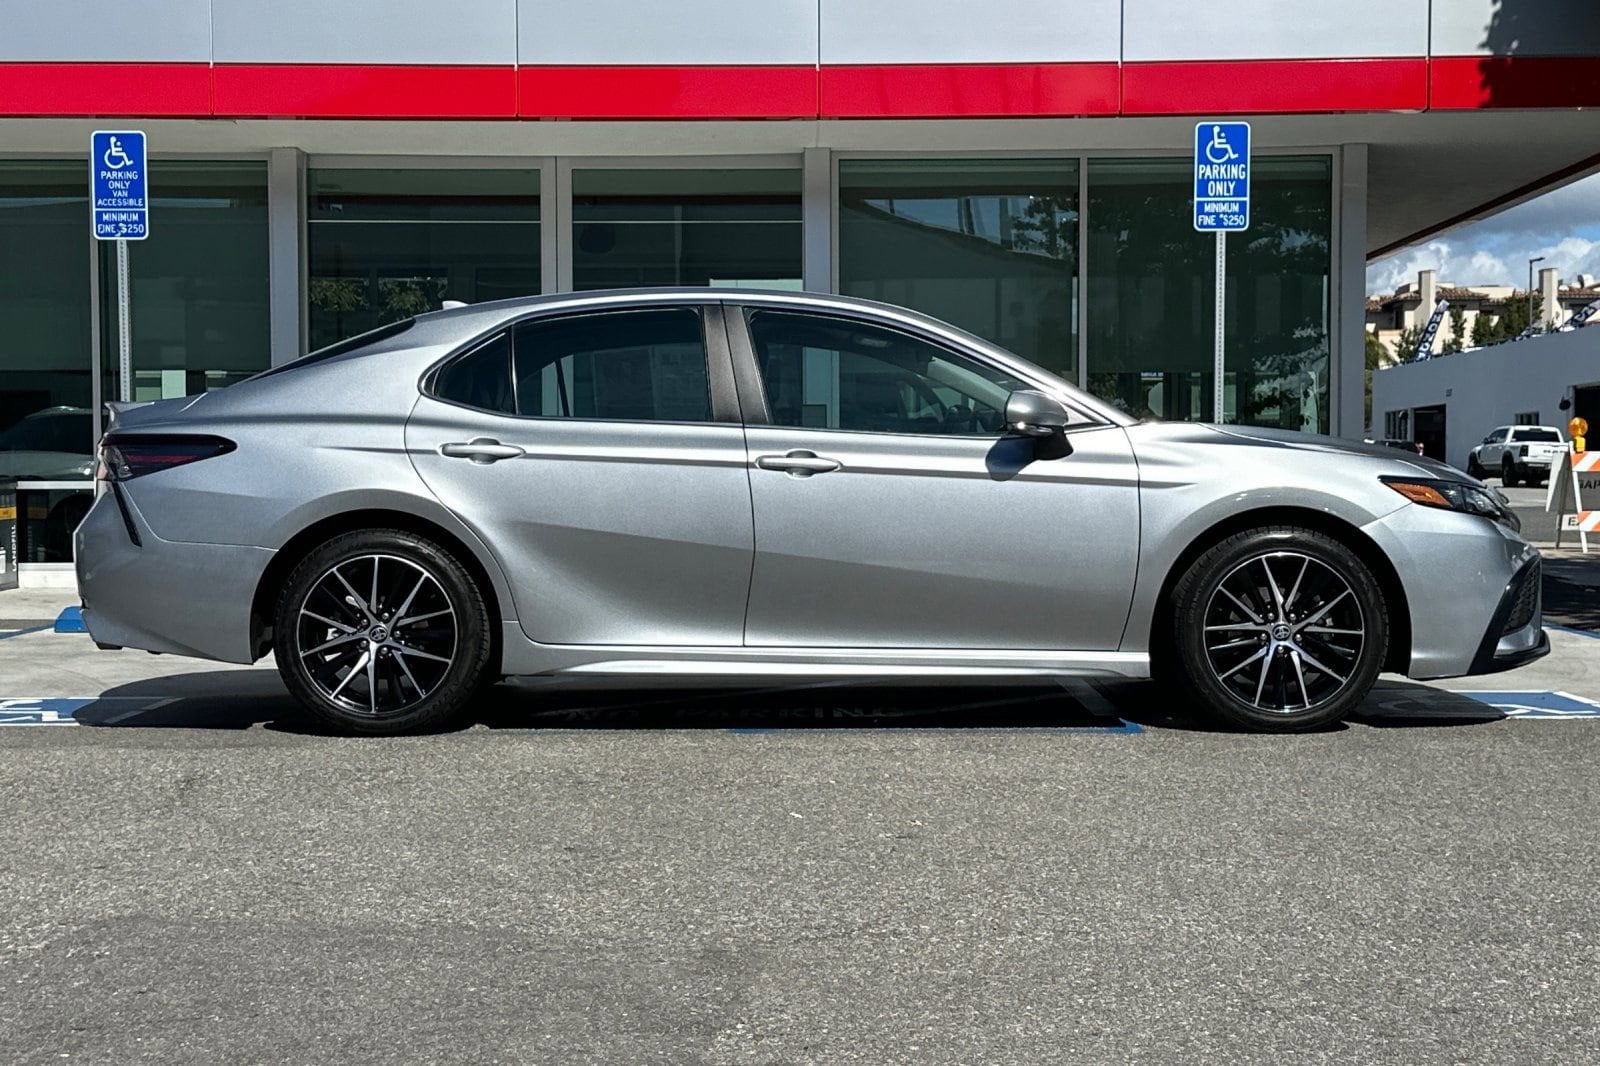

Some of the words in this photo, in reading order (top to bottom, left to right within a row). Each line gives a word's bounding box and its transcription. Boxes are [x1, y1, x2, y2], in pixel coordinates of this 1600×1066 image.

[101, 171, 138, 180] PARKING
[1199, 164, 1246, 180] PARKING
[108, 180, 130, 189] ONLY
[1208, 181, 1236, 196] ONLY
[97, 198, 143, 206] ACCESSIBLE
[1204, 202, 1240, 213] MINIMUM
[102, 212, 139, 222] MINIMUM
[1198, 214, 1216, 226] FINE
[1222, 214, 1245, 226] $250
[97, 224, 116, 234] FINE
